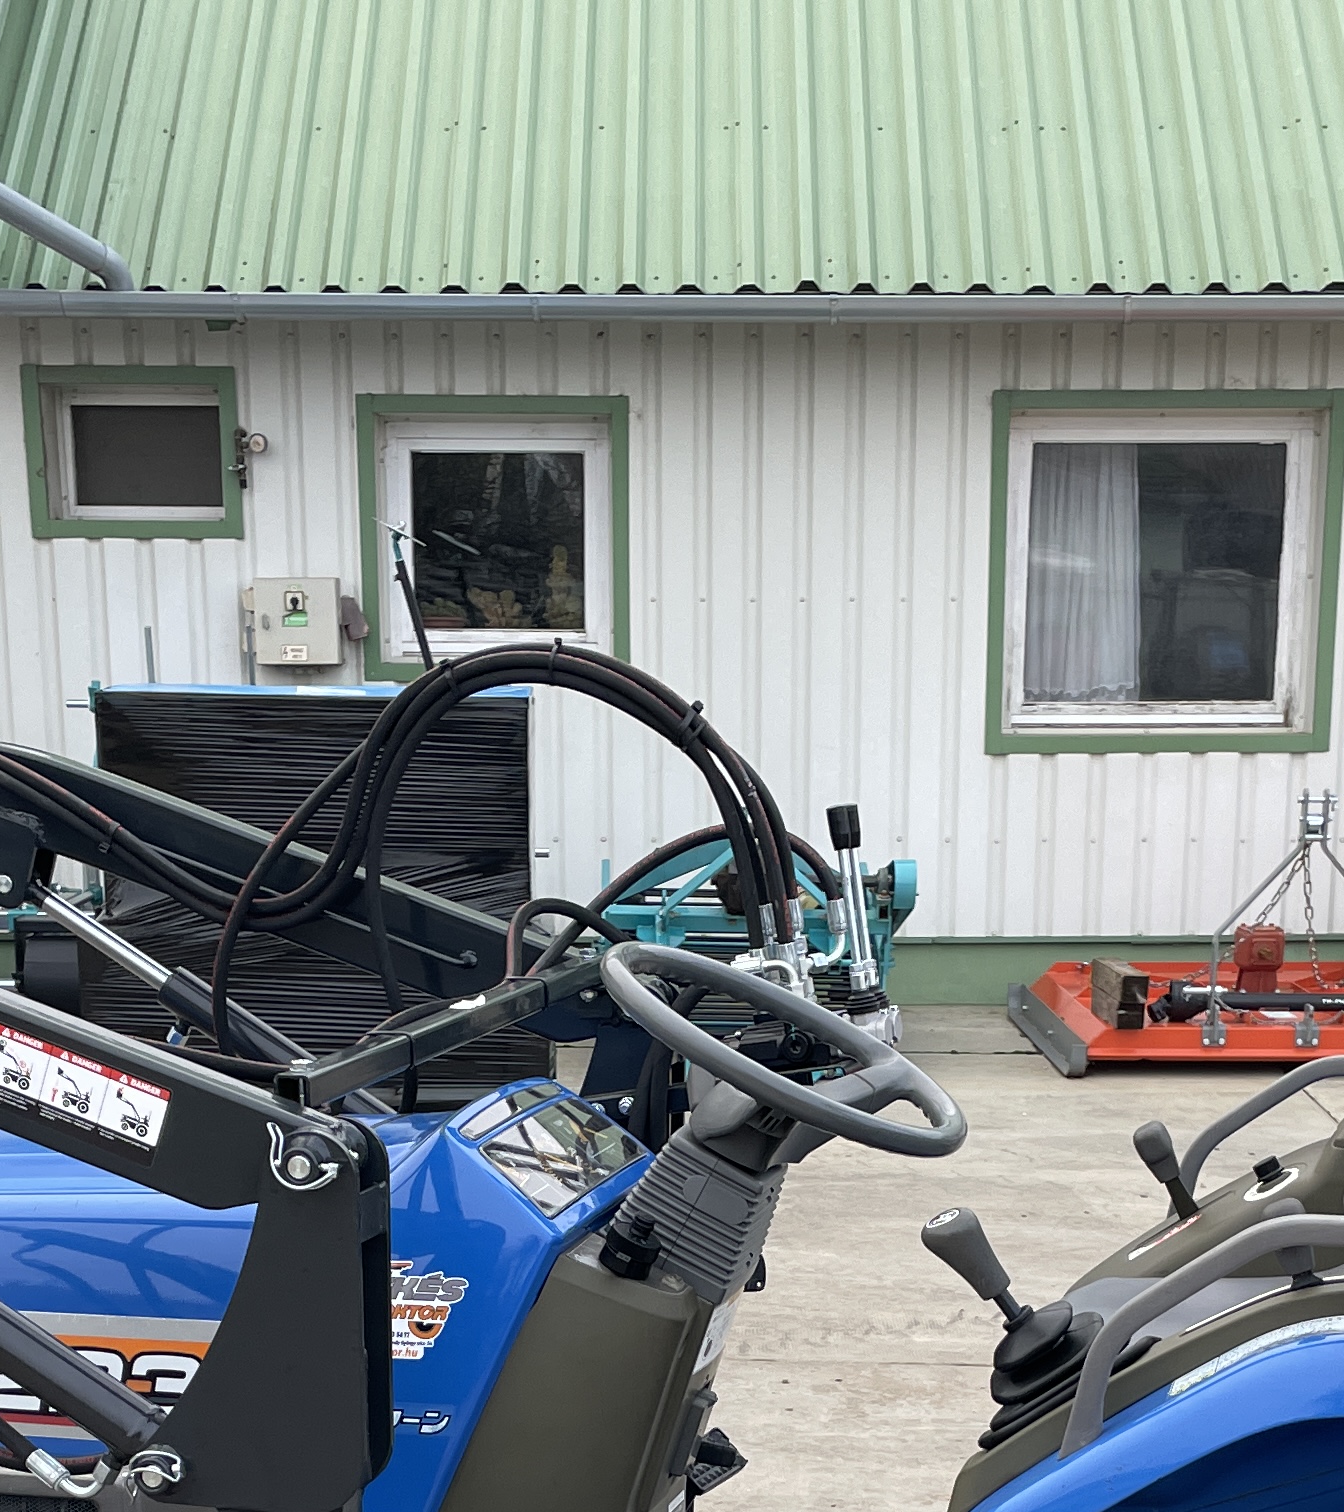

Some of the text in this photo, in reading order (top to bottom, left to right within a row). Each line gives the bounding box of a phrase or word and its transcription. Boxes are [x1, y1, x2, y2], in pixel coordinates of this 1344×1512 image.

[12, 1031, 44, 1050] DANGER
[71, 1054, 103, 1074] DANGER
[130, 1077, 162, 1097] DANGER
